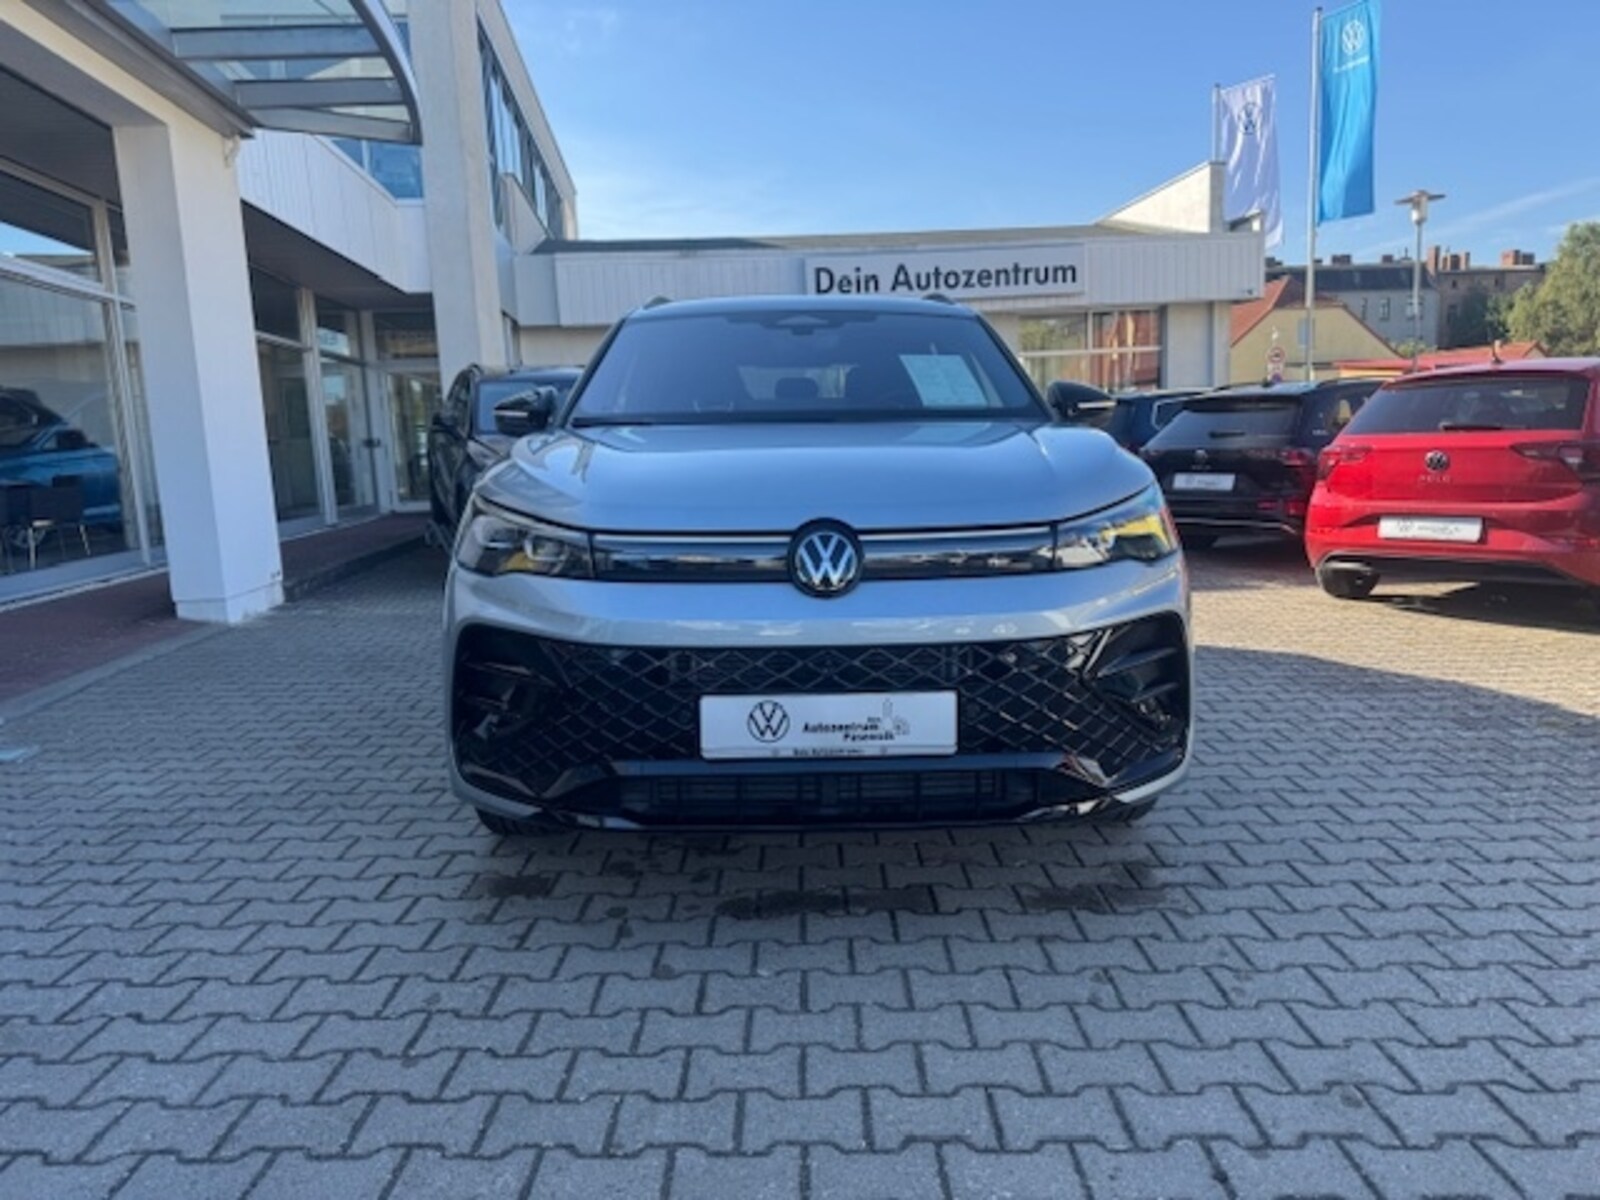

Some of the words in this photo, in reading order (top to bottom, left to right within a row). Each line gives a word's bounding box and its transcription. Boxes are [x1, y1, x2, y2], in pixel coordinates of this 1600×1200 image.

[814, 266, 879, 295] Dein
[890, 262, 1077, 291] Autozentrum
[795, 531, 857, 590] VW
[748, 701, 789, 741] VW
